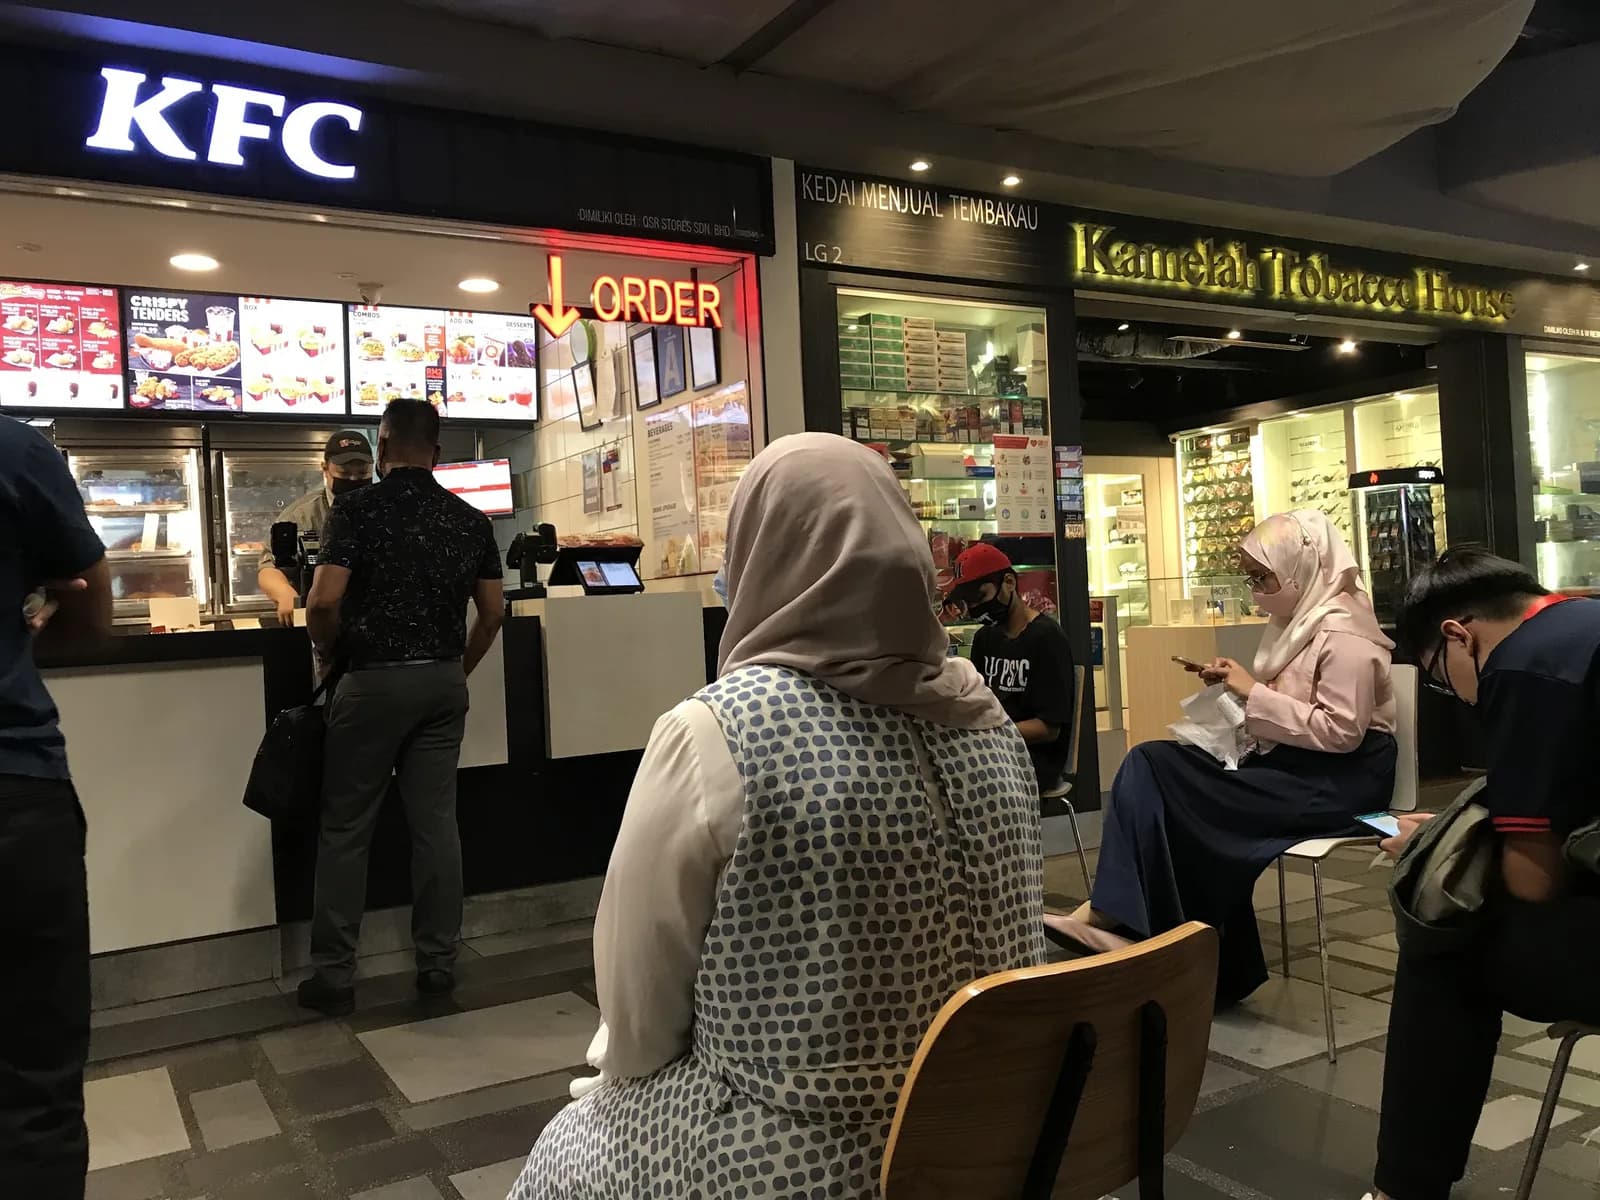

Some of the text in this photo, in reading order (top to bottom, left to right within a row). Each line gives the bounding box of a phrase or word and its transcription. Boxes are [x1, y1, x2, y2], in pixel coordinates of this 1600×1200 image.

[85, 67, 363, 180] KFC
[801, 172, 1039, 231] KEDAI MENJUAL TEMBAKAU
[614, 211, 636, 226] OLEH
[661, 217, 692, 233] STORES
[805, 242, 843, 264] LG 2
[1072, 222, 1518, 321] Kamelah Tobacco House
[130, 295, 188, 310] CRISPY
[243, 303, 258, 311] BOX
[592, 275, 723, 328] ORDER
[130, 306, 190, 322] TENDERS
[353, 311, 381, 319] COMBOS
[505, 321, 534, 329] DESSERTS
[647, 421, 673, 438] BEVERAGES
